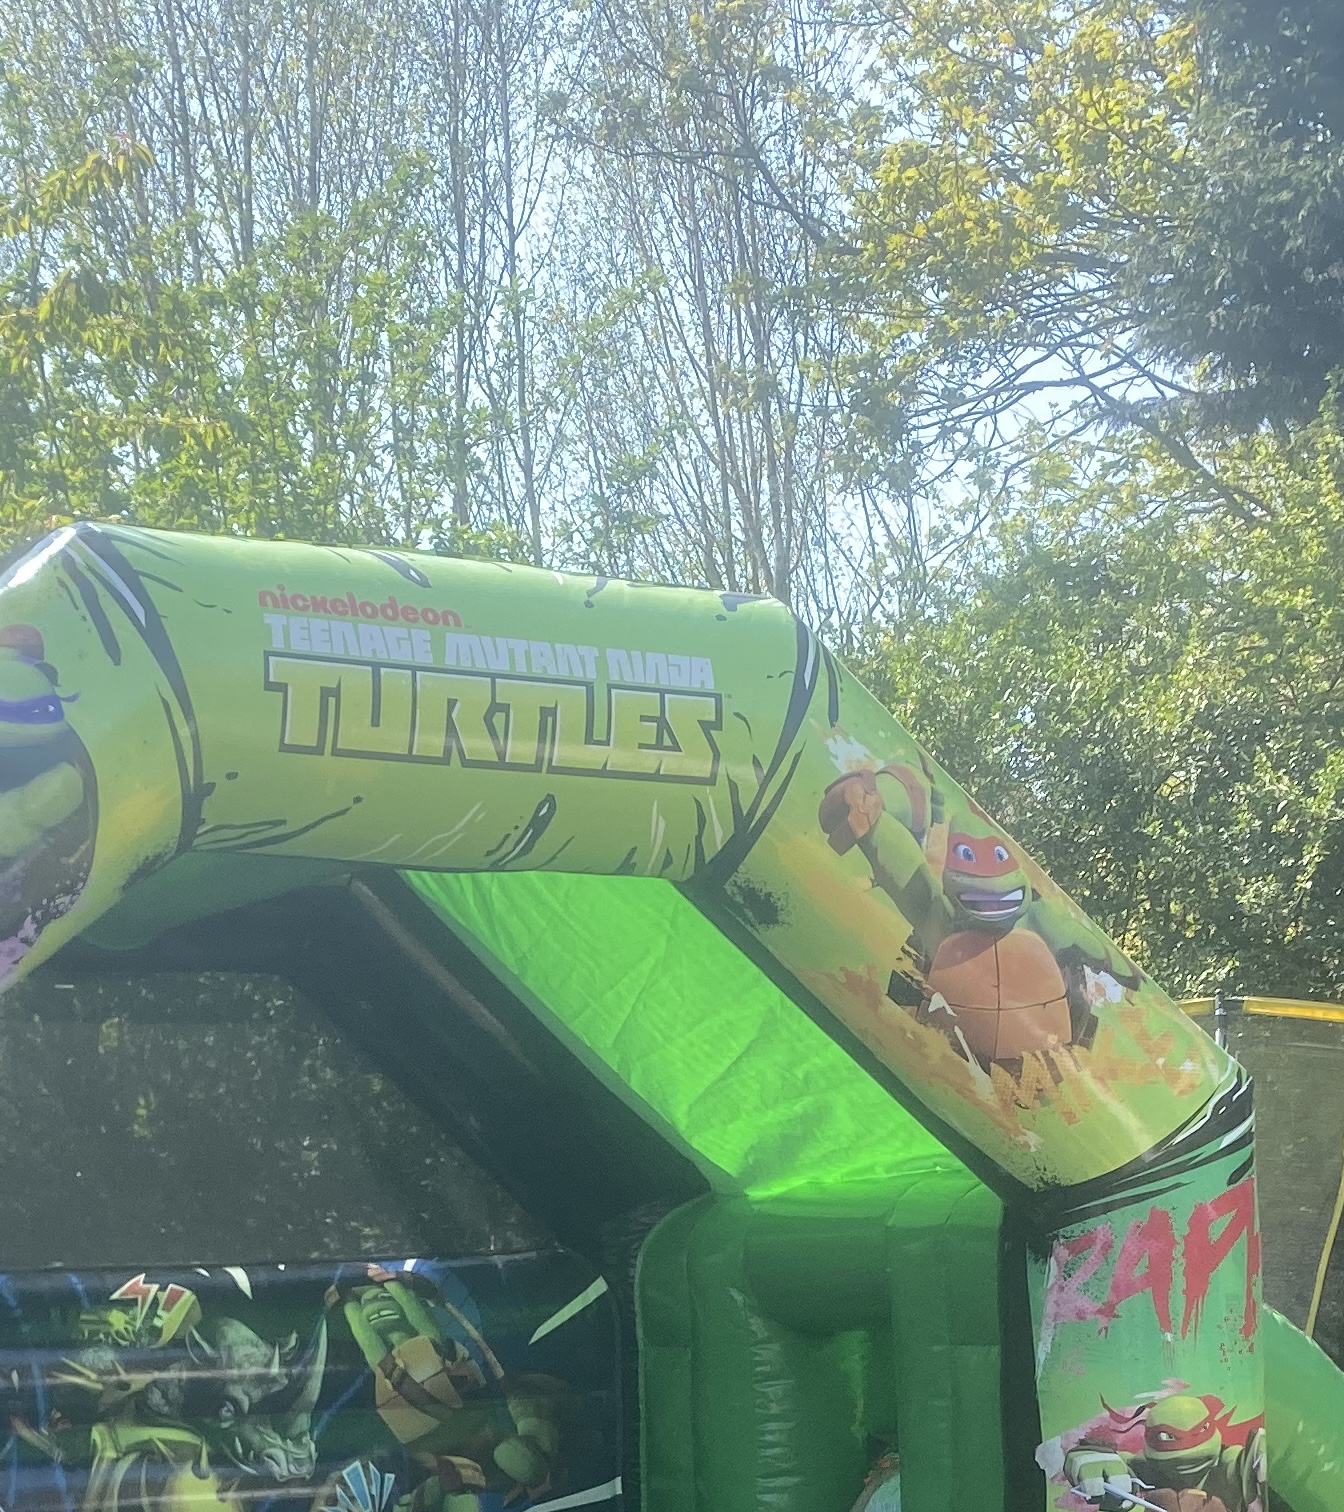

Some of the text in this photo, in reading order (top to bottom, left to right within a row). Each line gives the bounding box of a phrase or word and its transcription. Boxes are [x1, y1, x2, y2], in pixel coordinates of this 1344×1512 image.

[258, 583, 462, 628] nickelodeon
[263, 613, 714, 689] TEENAGE MUTANT NINJA
[263, 650, 723, 786] TURTLES
